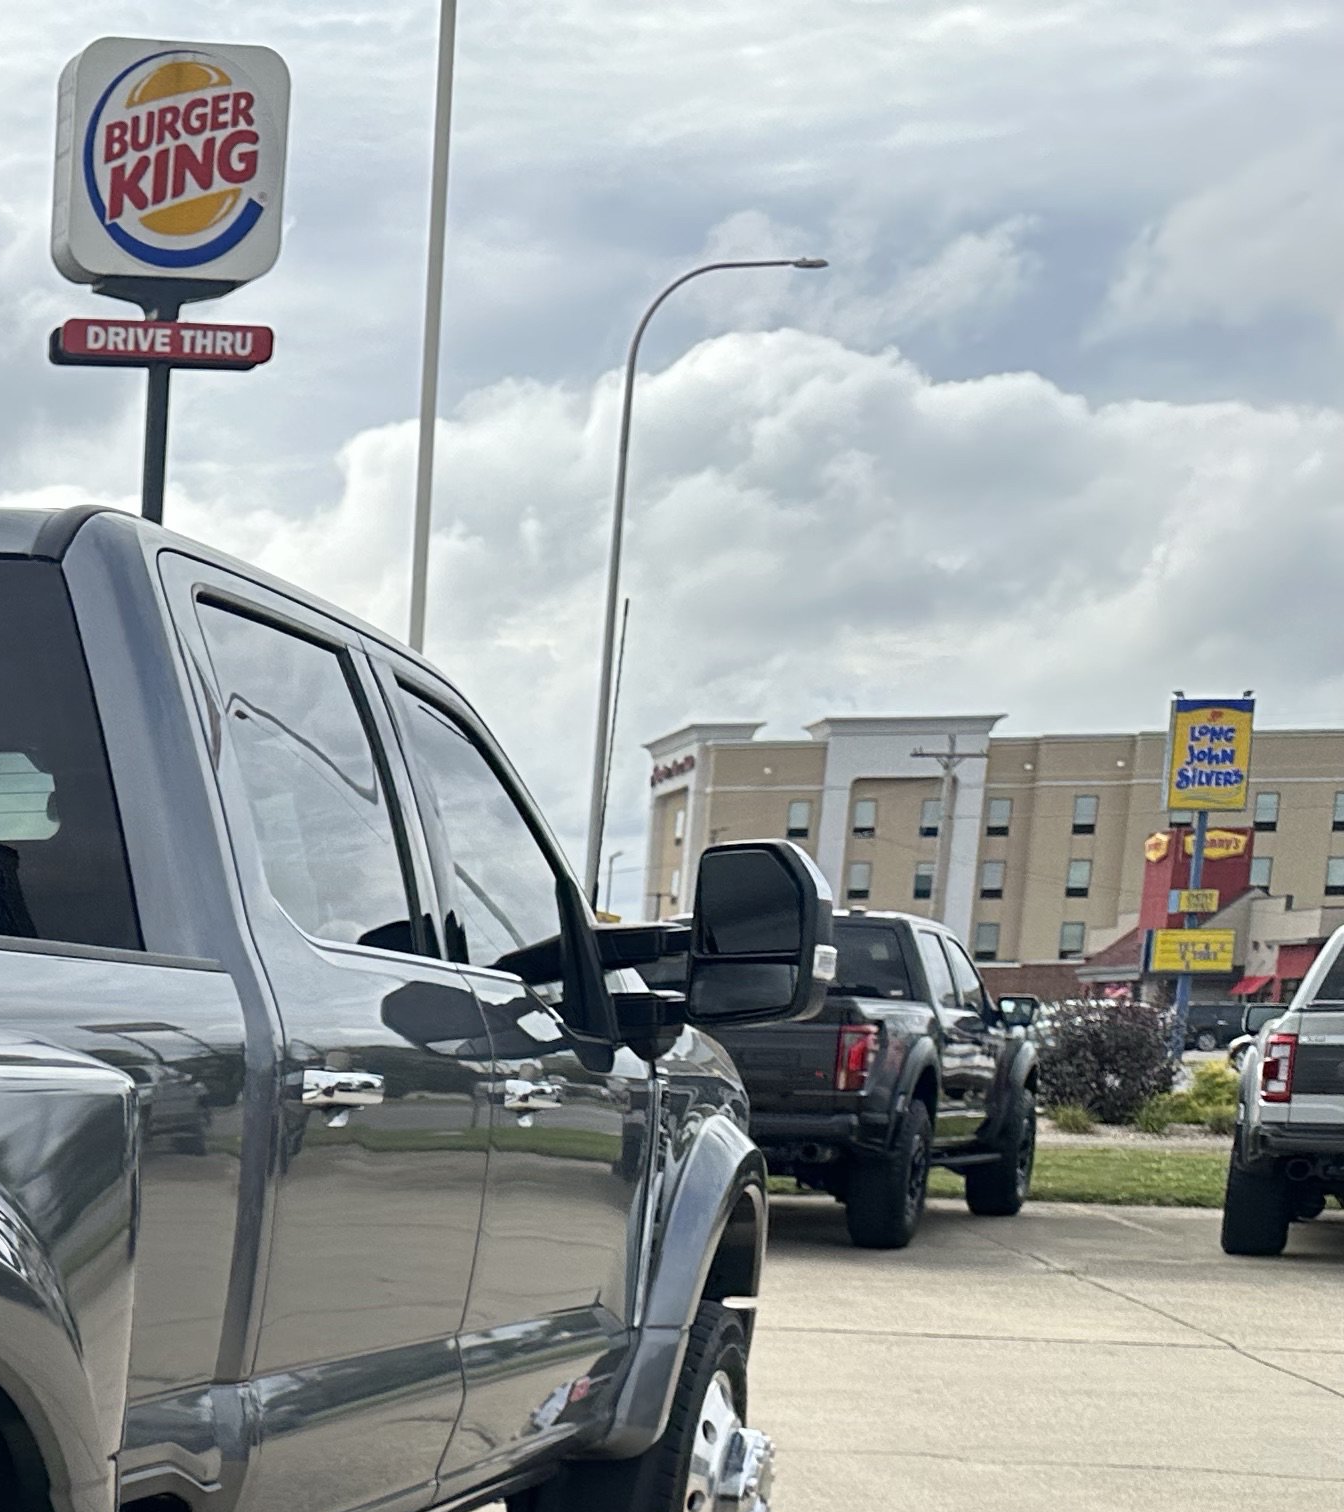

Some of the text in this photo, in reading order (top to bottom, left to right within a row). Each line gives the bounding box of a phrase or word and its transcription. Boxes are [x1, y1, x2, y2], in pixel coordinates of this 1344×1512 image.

[103, 91, 256, 164] BURGER
[108, 129, 260, 221] KING
[86, 325, 254, 357] DRIVE THRU
